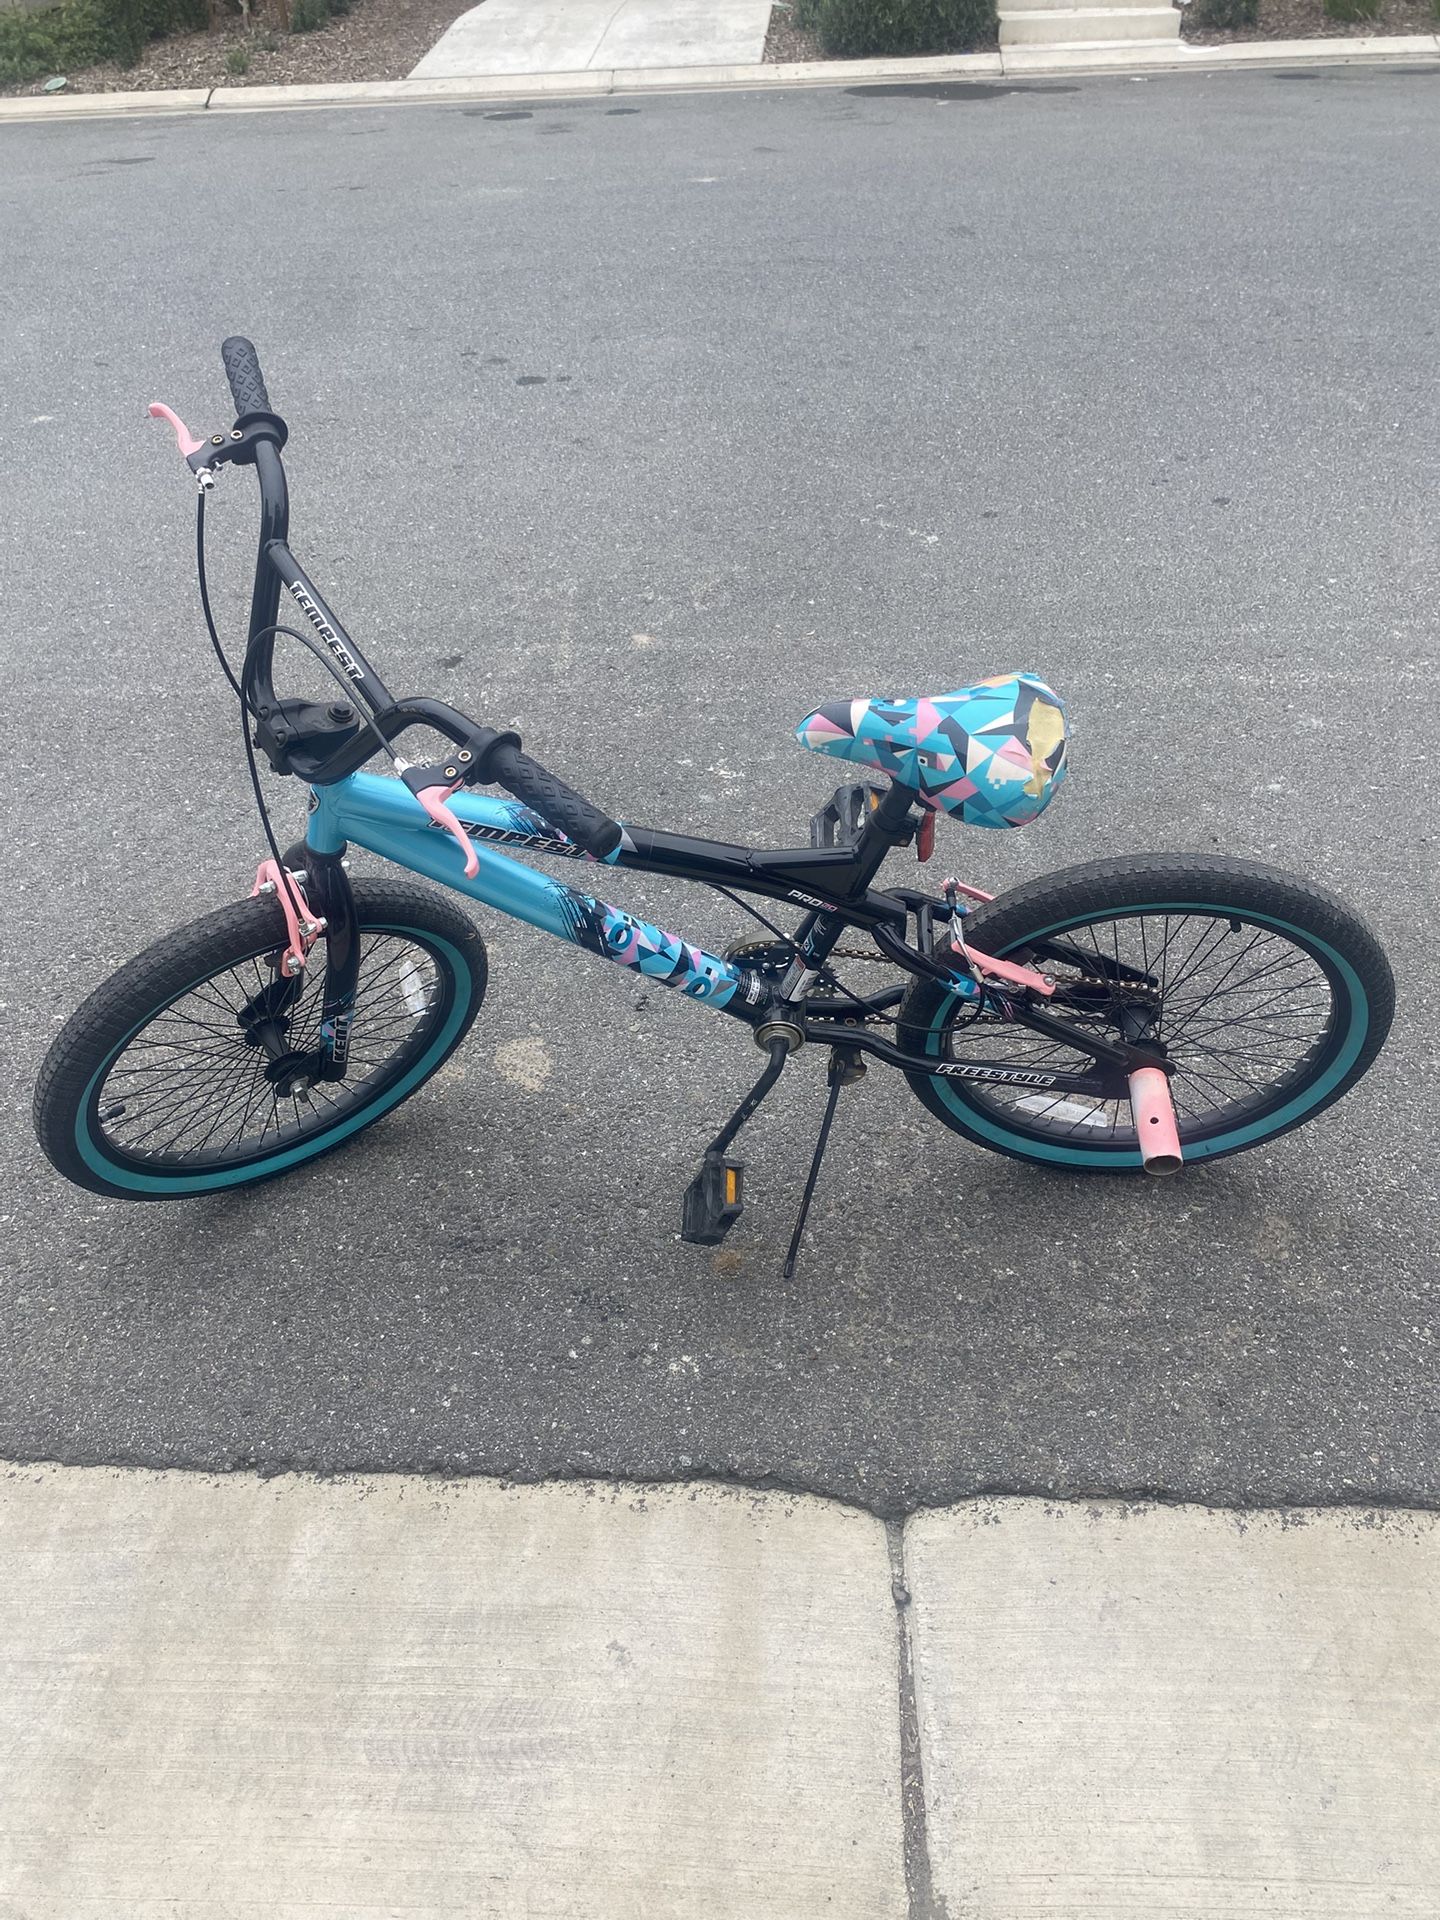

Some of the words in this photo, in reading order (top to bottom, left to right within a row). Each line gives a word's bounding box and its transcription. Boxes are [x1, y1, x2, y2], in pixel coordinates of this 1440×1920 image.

[288, 580, 365, 679] TEMPEST
[332, 1016, 350, 1062] KENT
[936, 1063, 1056, 1087] FREESTYLE
